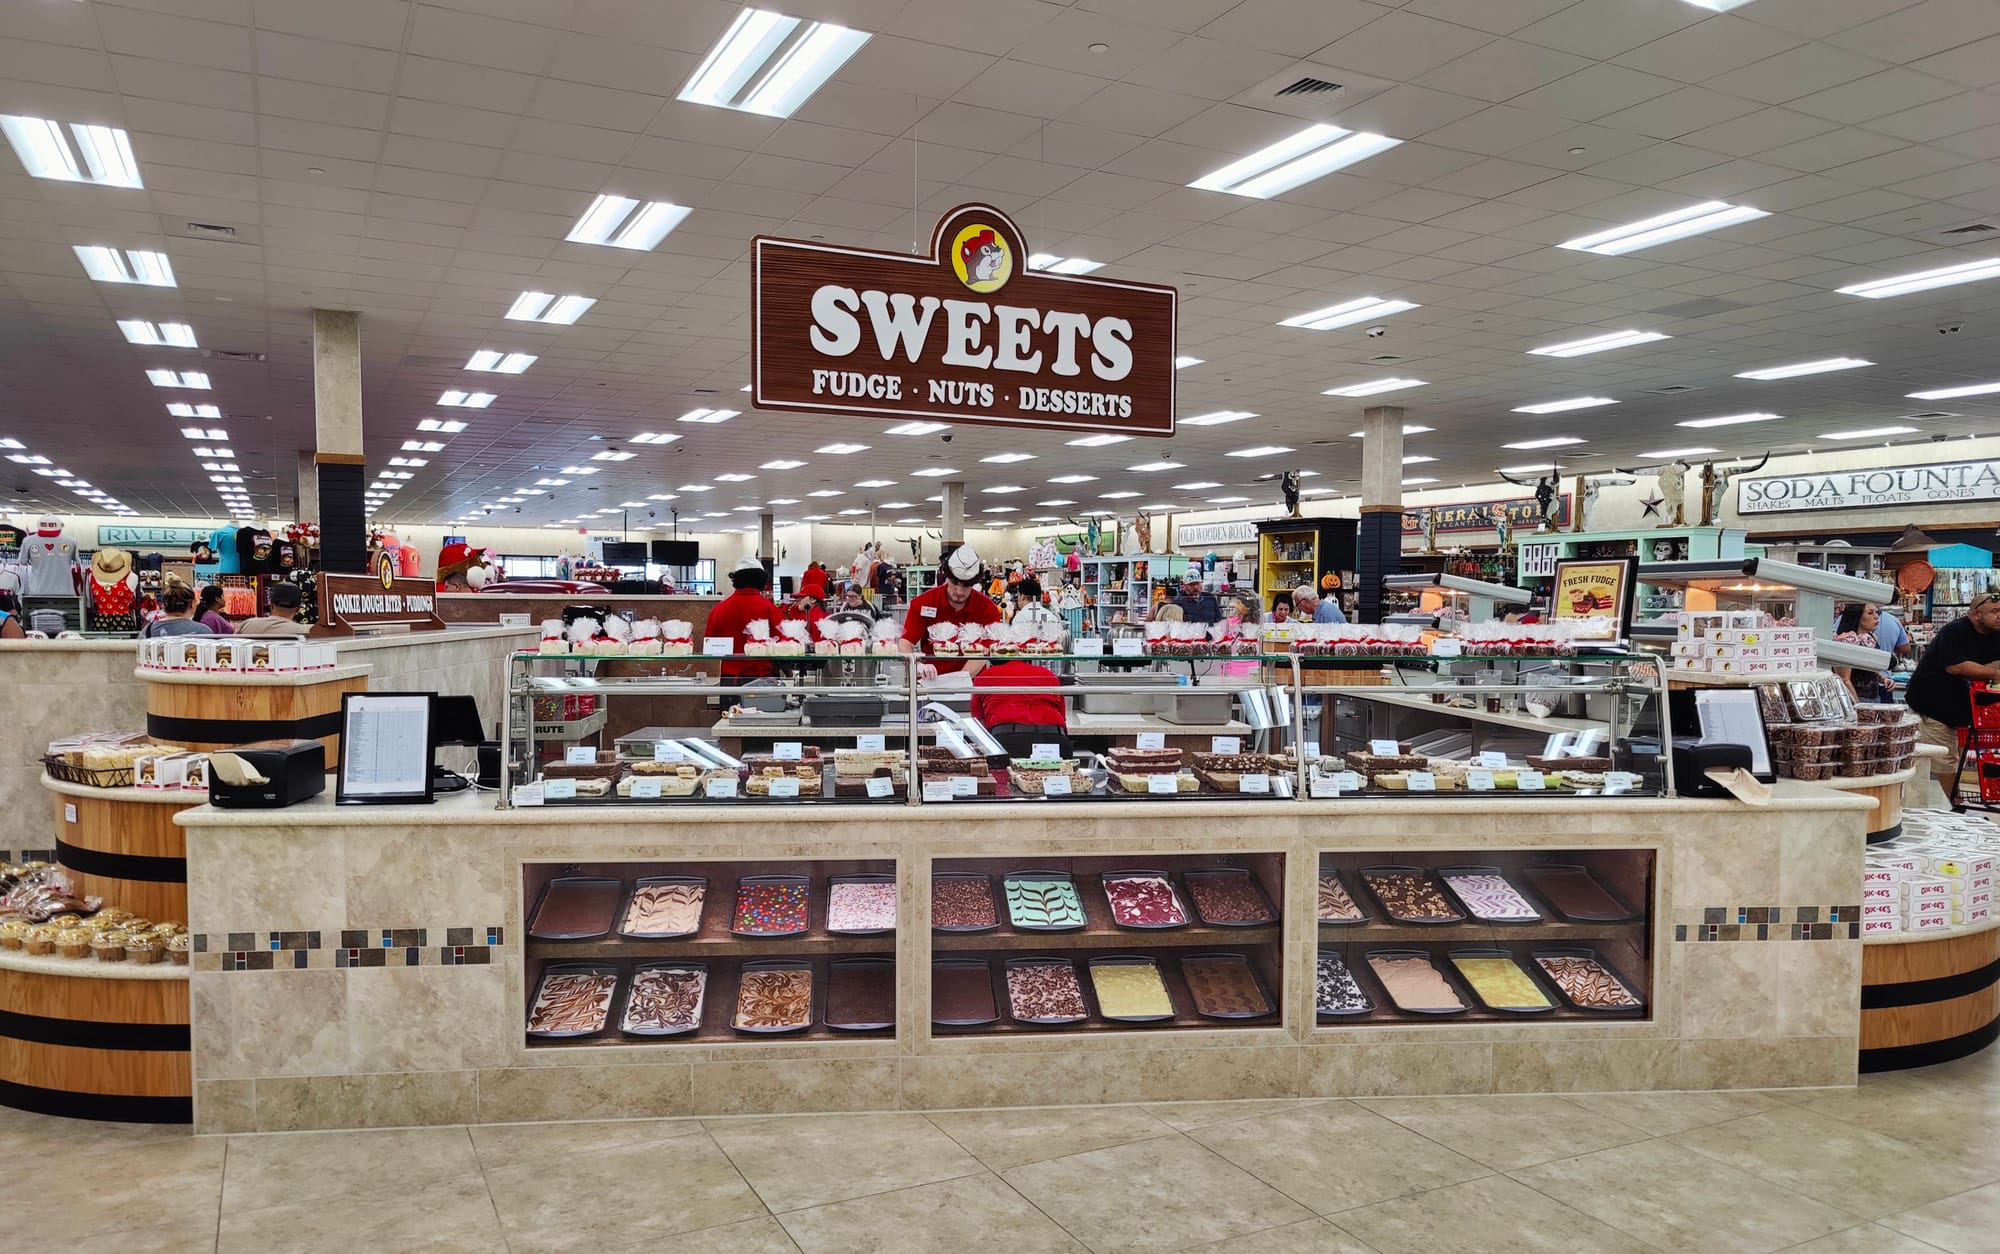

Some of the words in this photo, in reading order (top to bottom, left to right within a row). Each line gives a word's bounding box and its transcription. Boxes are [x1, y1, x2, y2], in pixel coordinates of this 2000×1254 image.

[809, 284, 1133, 382] SWEETS
[811, 369, 902, 401] FUDGE
[928, 379, 994, 408] NUTS
[1018, 386, 1132, 419] DESSERTS
[1746, 477, 1841, 502] SODA
[1746, 499, 1791, 511] SHAKES
[1805, 496, 1845, 507] MALTS
[1862, 492, 1911, 504] FLOATS
[1927, 487, 1975, 499] CONES
[1181, 528, 1195, 543] OLD
[1196, 526, 1227, 542] WOODEN
[1228, 524, 1252, 540] BOATS
[1436, 520, 1489, 529] ERCANTILE
[107, 528, 177, 541] RIVER
[1563, 575, 1589, 588] FRESH
[1590, 575, 1617, 587] FUDGE
[333, 593, 361, 614] COOKIE
[361, 594, 384, 613] DOUGH
[385, 594, 402, 613] BITES
[1864, 905, 1891, 914] BUC-EE'S
[1865, 921, 1892, 931] BUC-EE'S
